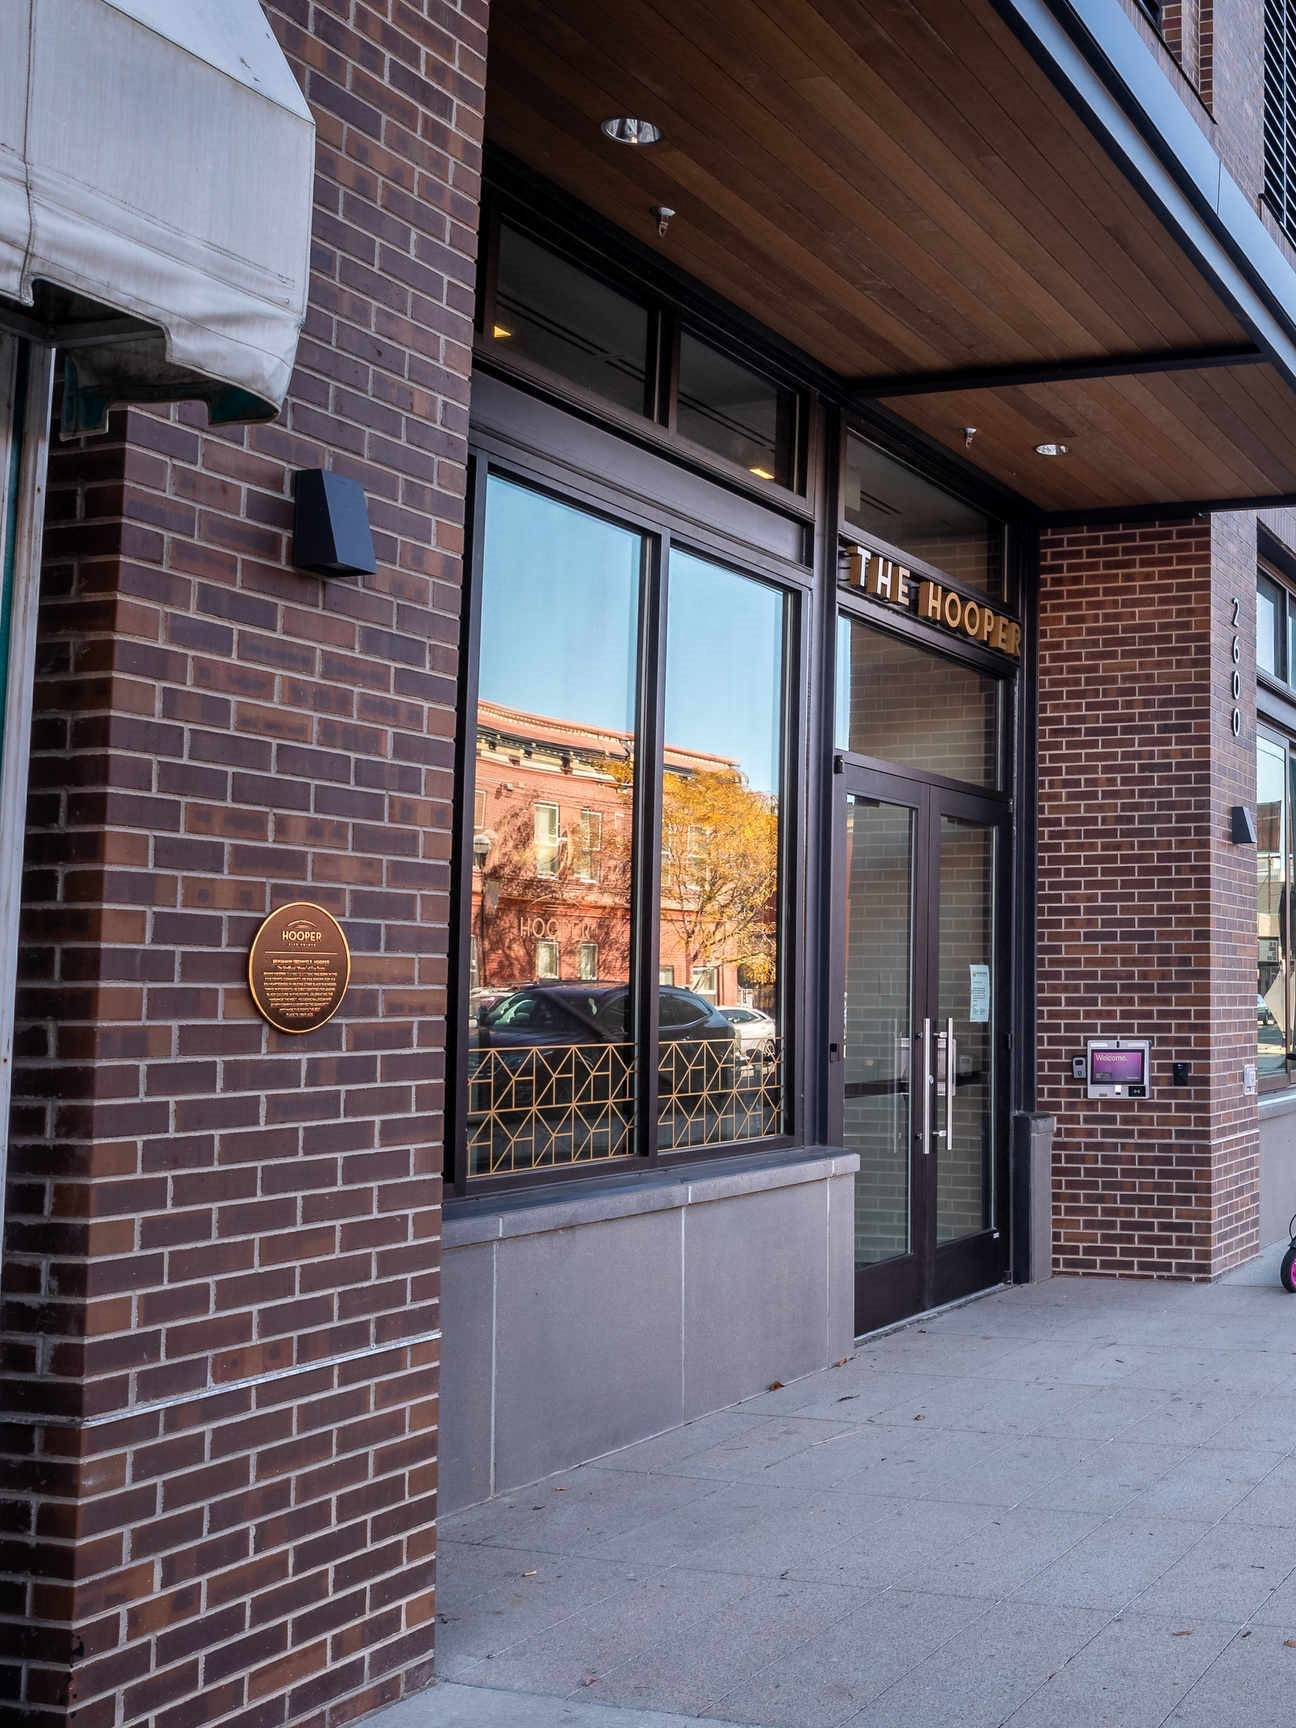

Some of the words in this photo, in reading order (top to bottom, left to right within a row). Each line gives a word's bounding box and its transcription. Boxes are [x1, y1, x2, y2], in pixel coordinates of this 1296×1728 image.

[848, 545, 911, 606] THE
[919, 580, 1021, 657] HOOPER
[1231, 597, 1241, 737] 2600
[282, 930, 322, 941] HOOPER
